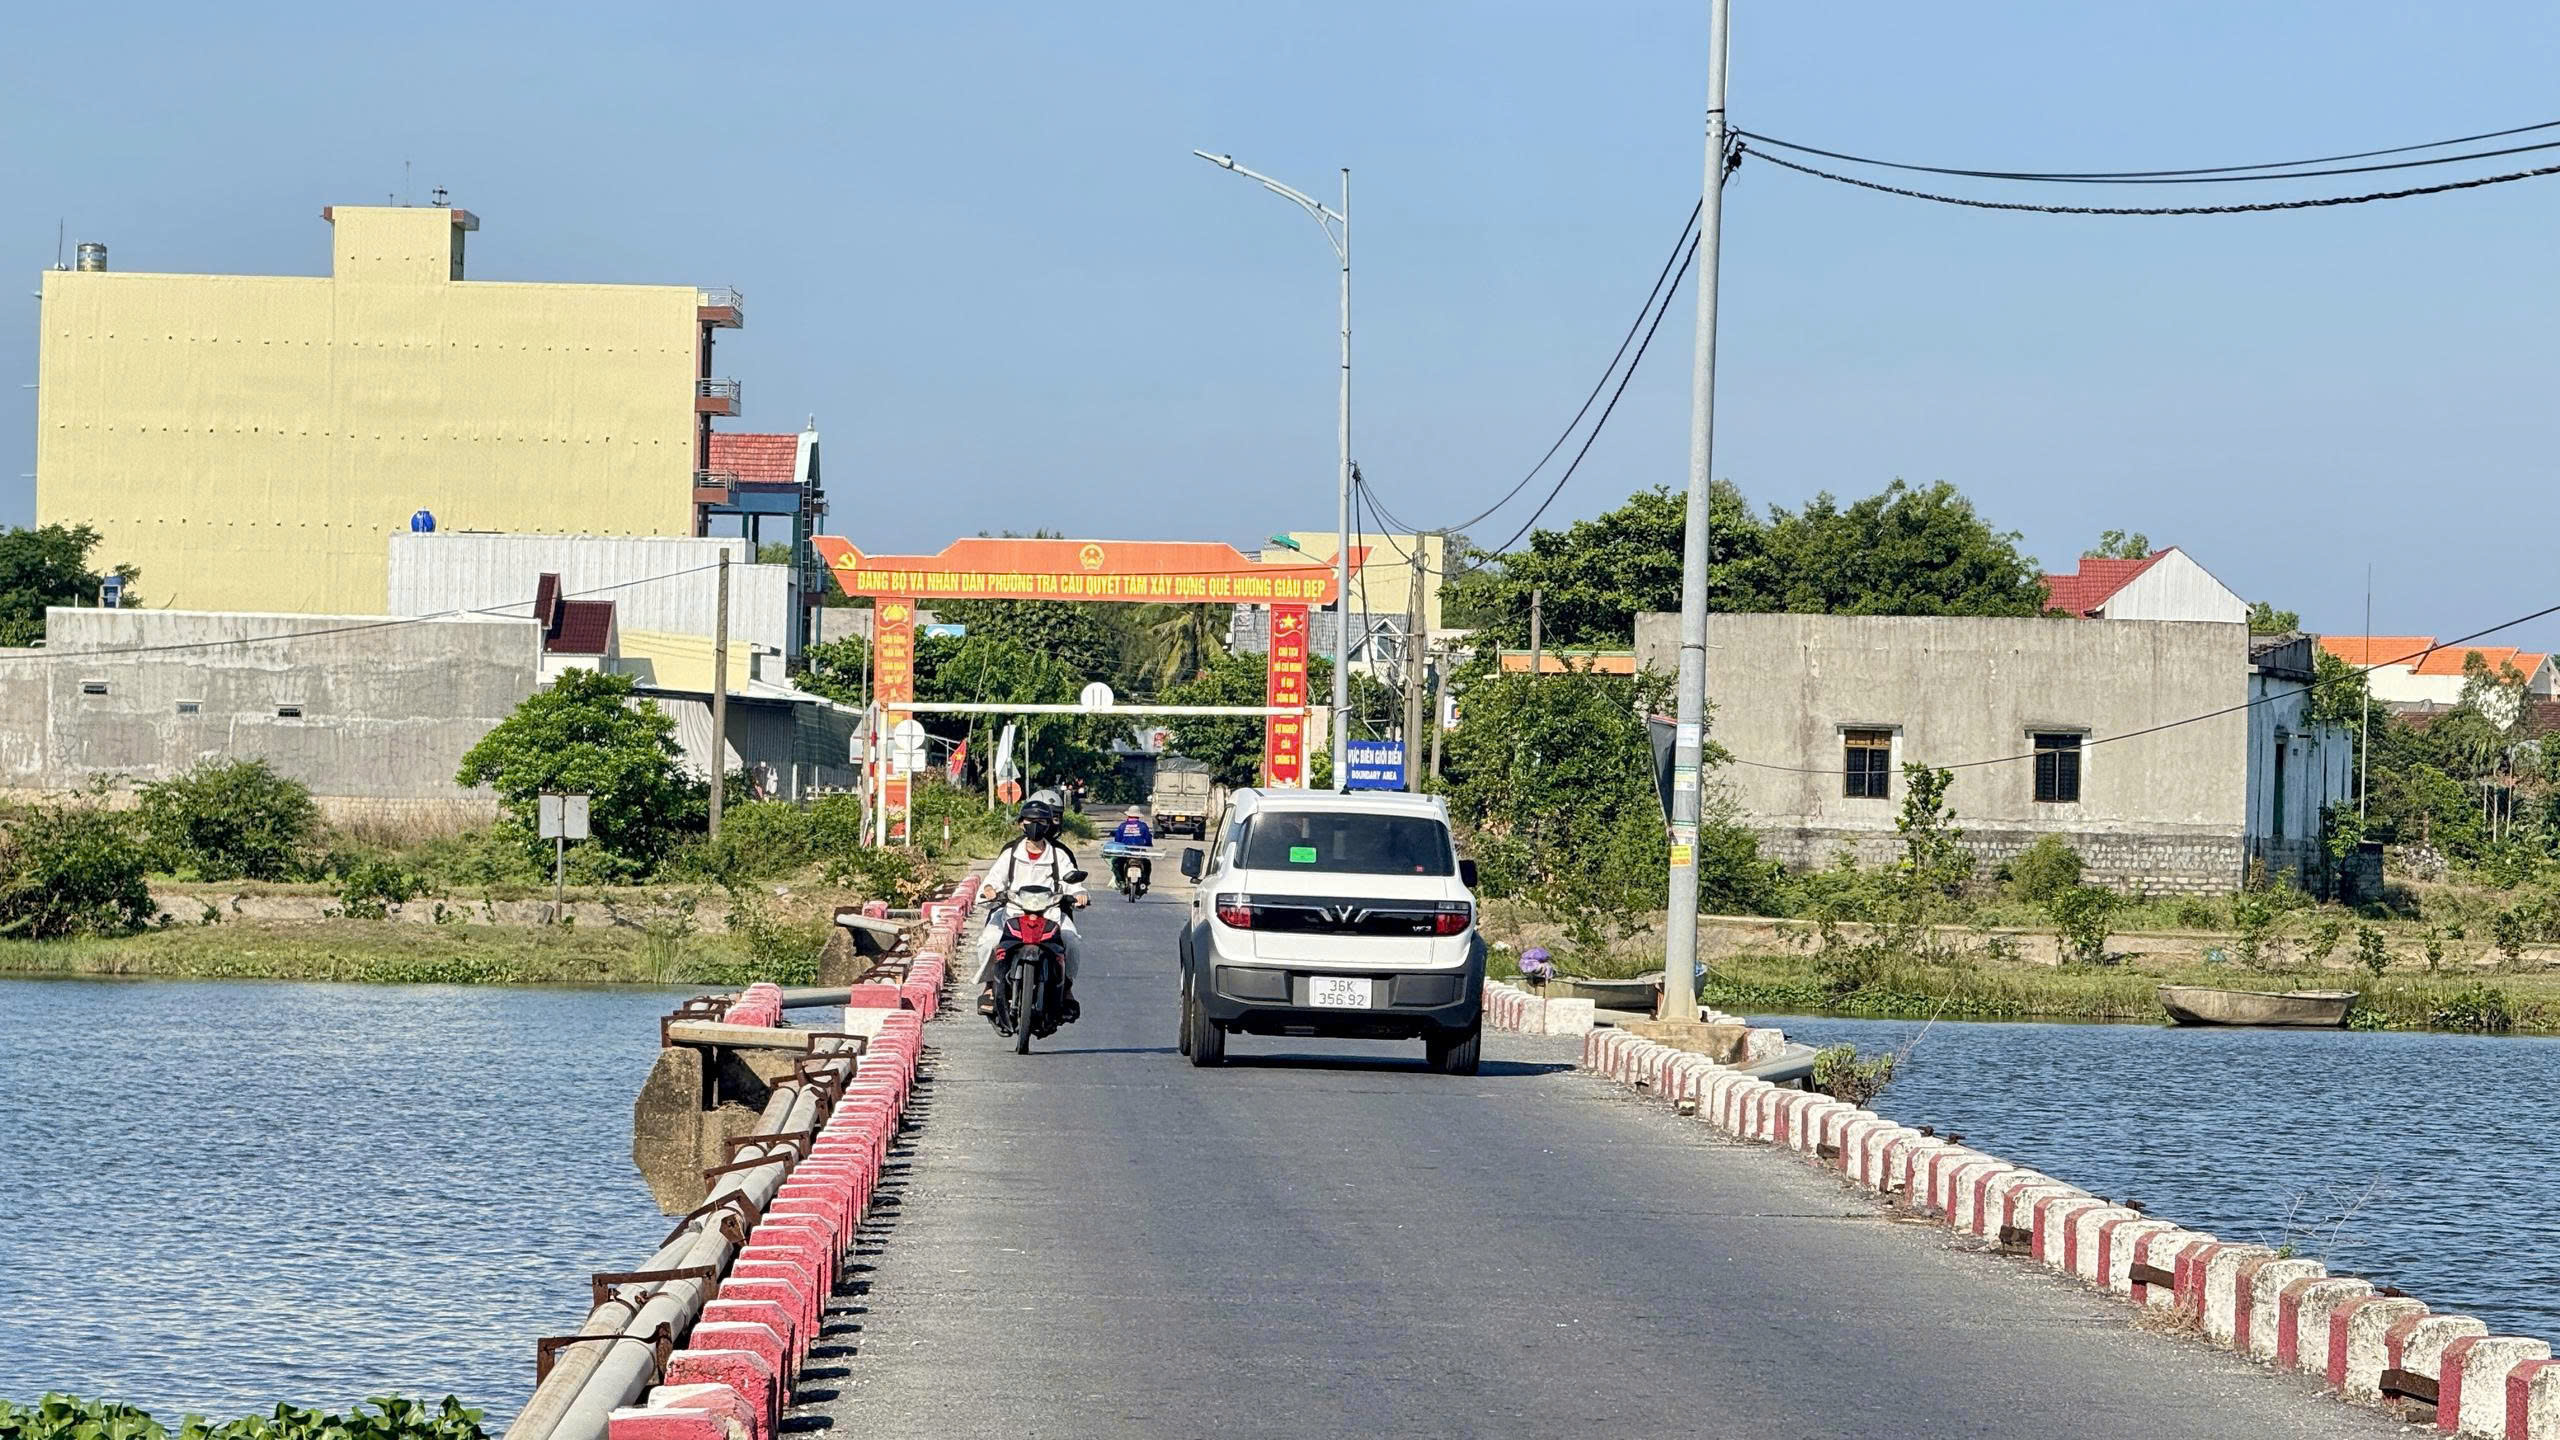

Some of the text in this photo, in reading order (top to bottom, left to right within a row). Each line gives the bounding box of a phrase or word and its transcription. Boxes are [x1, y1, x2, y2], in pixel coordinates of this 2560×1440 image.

[891, 568, 907, 595] BỘ
[927, 569, 960, 592] NHÂN
[961, 570, 985, 592] DÂN
[1086, 570, 1121, 596] QUYẾT
[1123, 573, 1148, 594] TÂM
[1150, 573, 1173, 595] XÂY
[1175, 575, 1206, 599] DỰNG
[1208, 574, 1231, 597] QUÊ
[1233, 575, 1272, 597] HƯƠNG
[1274, 575, 1301, 598] GIÀU
[1303, 578, 1326, 601] ĐẸP
[1360, 747, 1375, 764] BIÊN
[1351, 770, 1398, 780] BOUNDARY AREA
[1329, 979, 1354, 992] 36K
